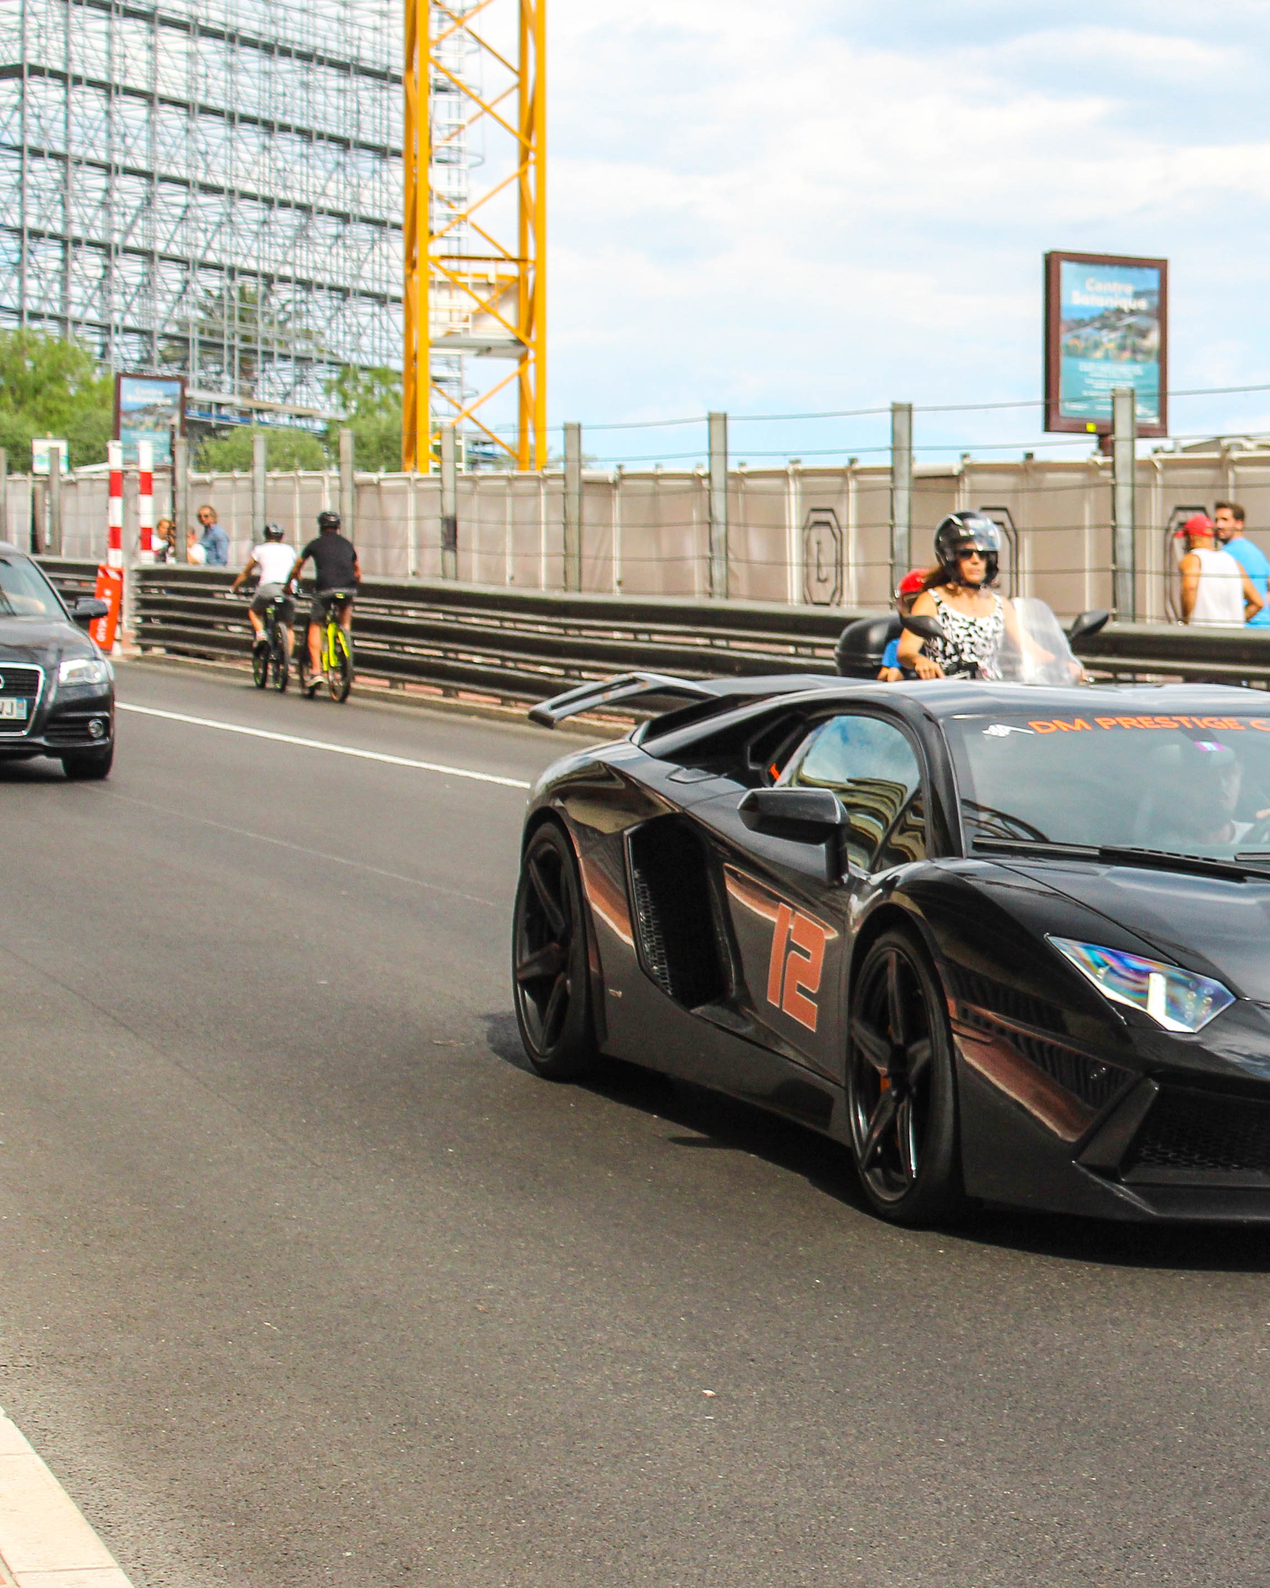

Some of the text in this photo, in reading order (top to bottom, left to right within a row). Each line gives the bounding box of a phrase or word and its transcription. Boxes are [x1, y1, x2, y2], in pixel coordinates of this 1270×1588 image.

[1085, 277, 1134, 294] Centre
[1071, 291, 1148, 312] Botanique
[816, 540, 827, 583] L
[1028, 719, 1093, 735] DM
[1094, 716, 1245, 731] PRESTIGE
[767, 902, 826, 1033] 12
